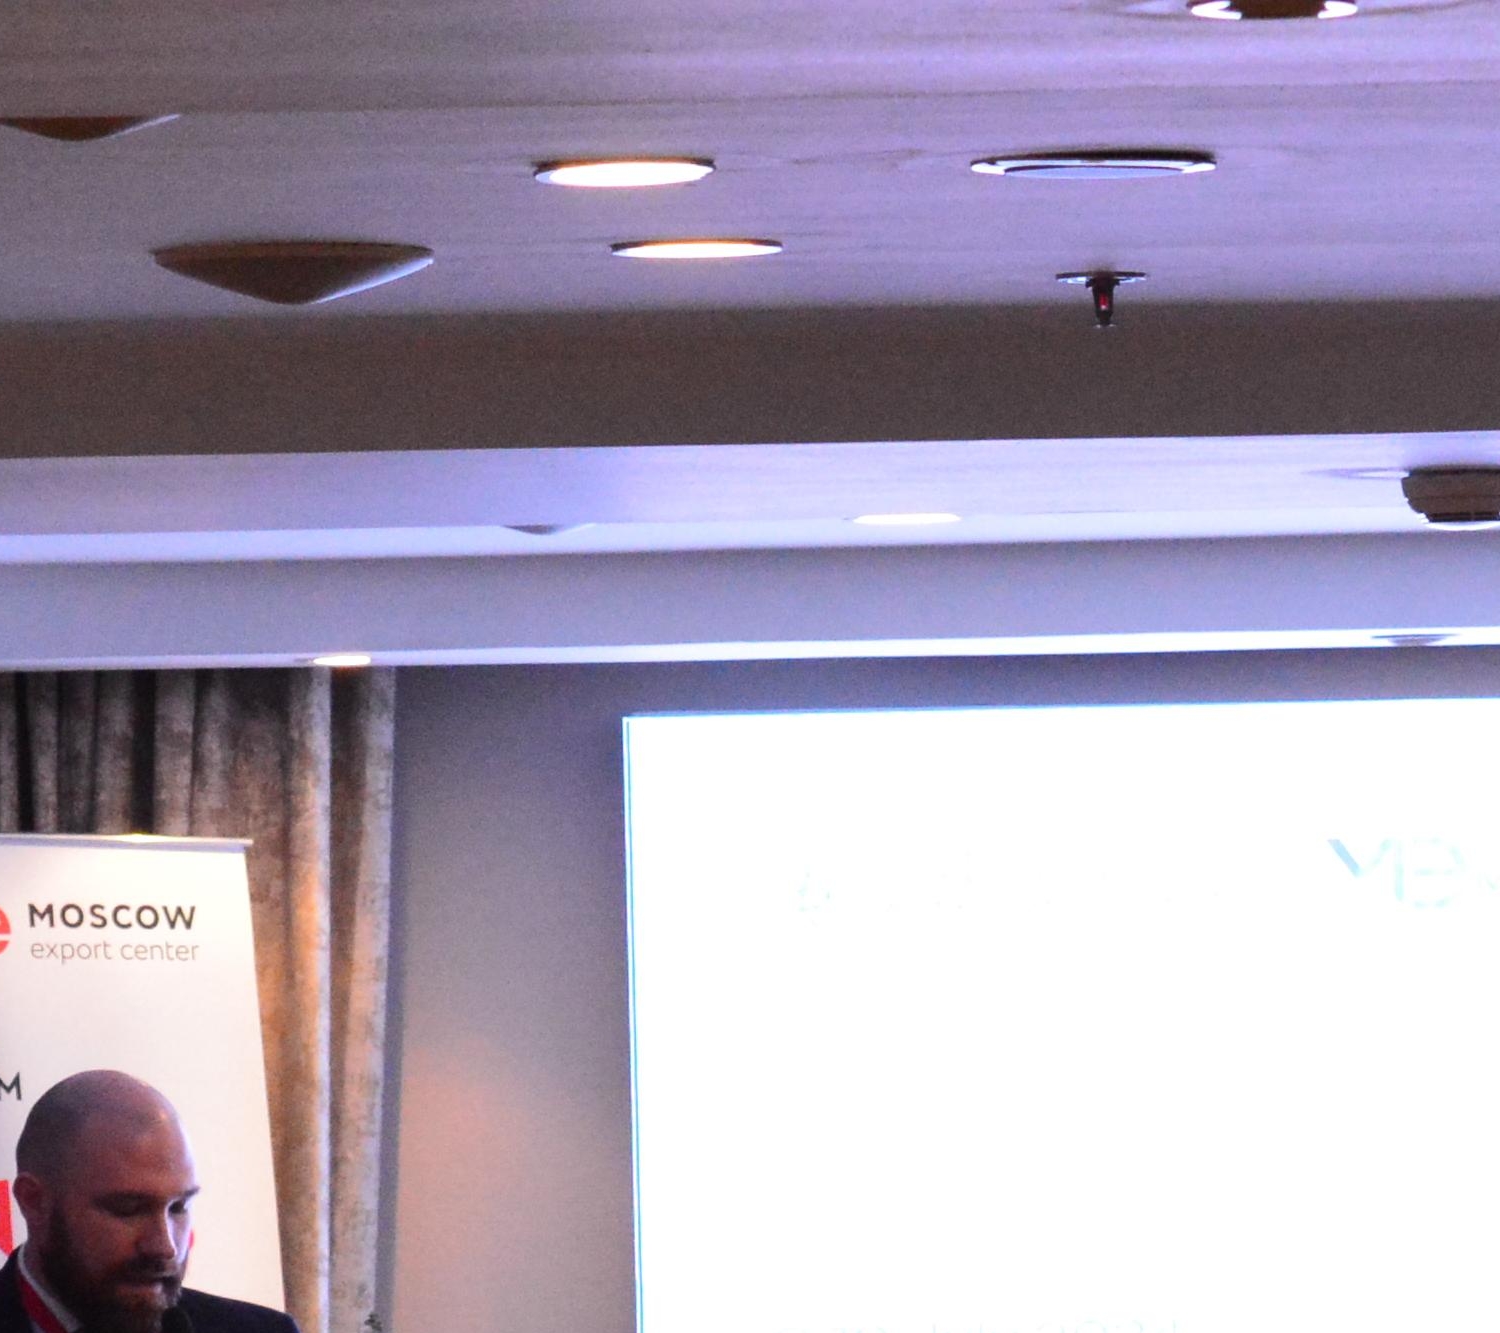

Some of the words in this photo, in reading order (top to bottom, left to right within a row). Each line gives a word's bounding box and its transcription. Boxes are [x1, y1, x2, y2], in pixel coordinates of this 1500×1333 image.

[27, 902, 197, 931] MOSCOW
[30, 941, 113, 965] export
[119, 940, 200, 962] center
